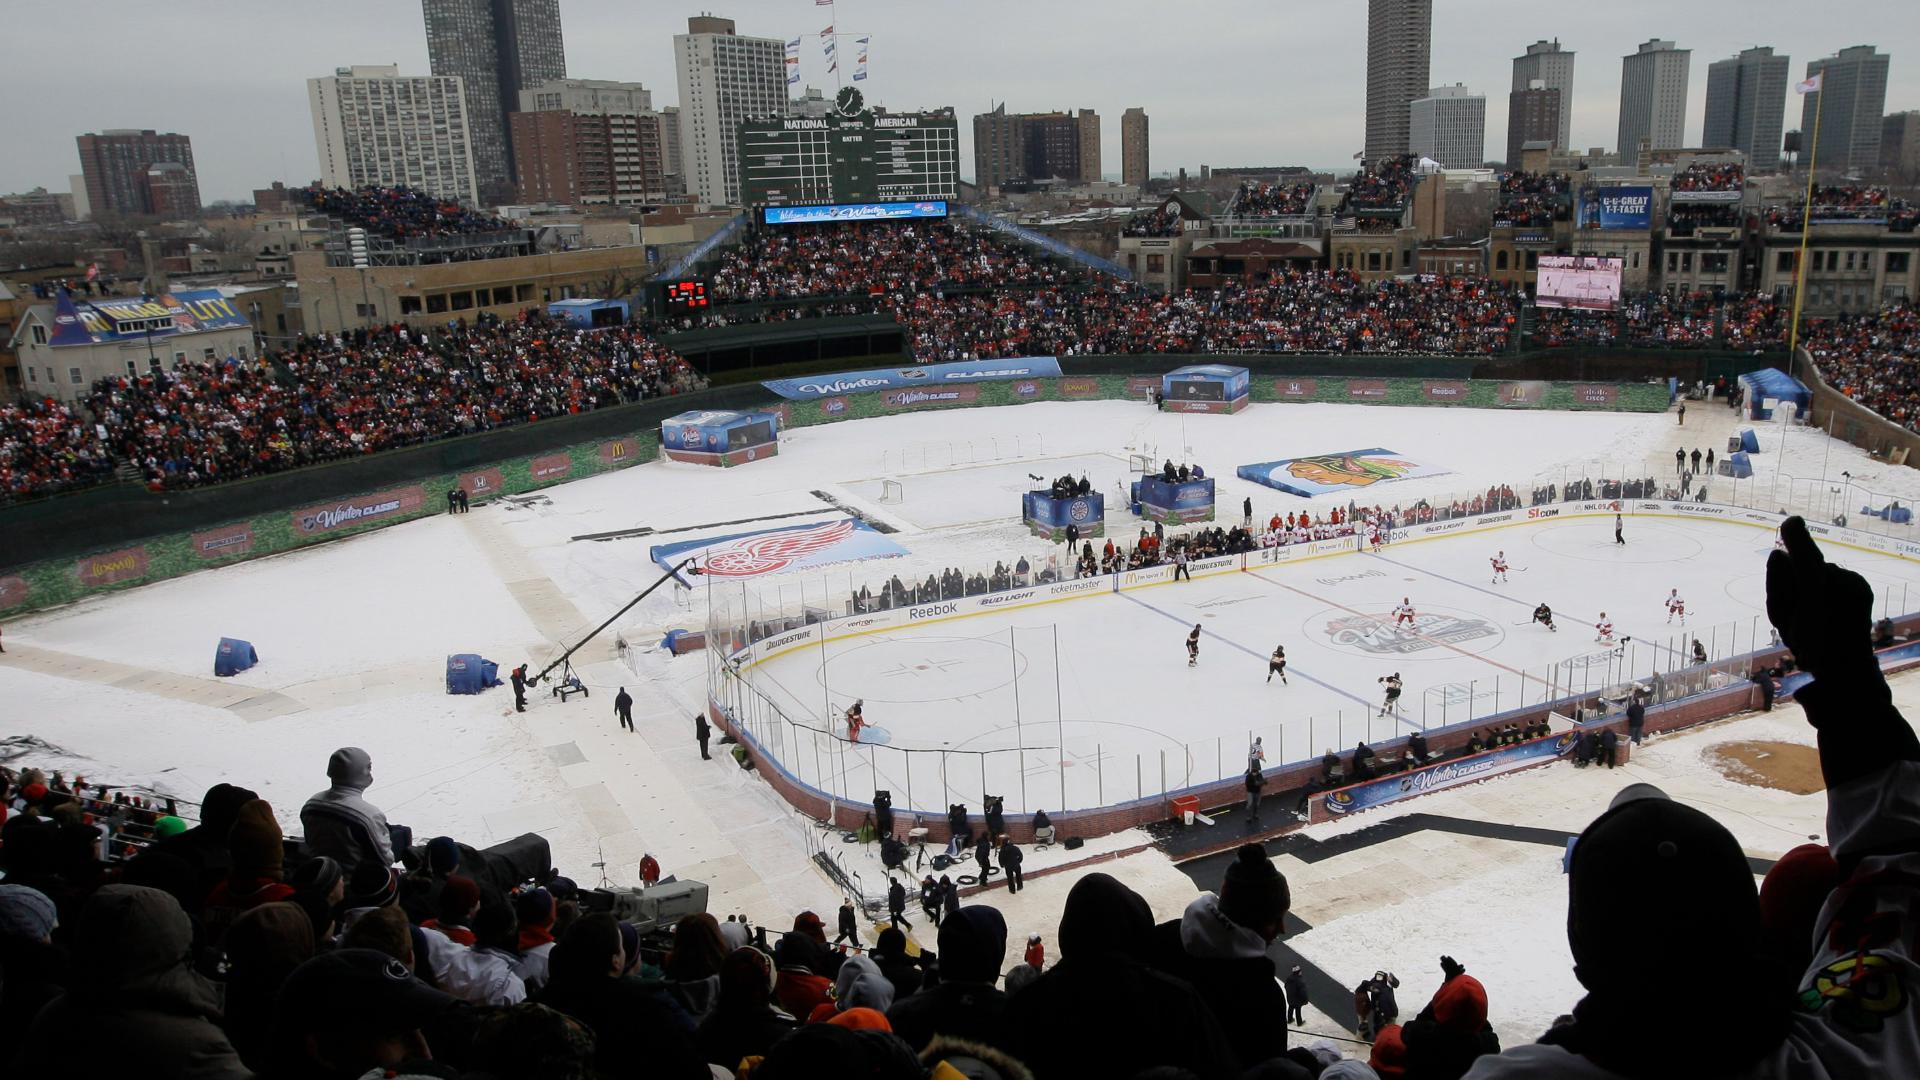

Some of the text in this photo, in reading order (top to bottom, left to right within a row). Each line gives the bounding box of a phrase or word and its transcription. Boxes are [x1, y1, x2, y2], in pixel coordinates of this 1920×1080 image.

[784, 119, 829, 130] NATIONAL
[874, 118, 917, 127] AMERICAN
[1603, 197, 1648, 205] G-G-GREAT
[840, 206, 886, 217] Winter
[1606, 205, 1645, 214] T-T-TASTE
[798, 368, 1030, 394] Winter CLASSIC
[897, 390, 959, 405] Winter CLASSIC
[316, 500, 400, 528] Winter CLASSIC
[1695, 506, 1724, 514] LIGHT
[1443, 521, 1465, 530] LIGHT
[1051, 580, 1101, 595] ticketmaster
[980, 591, 1036, 606] BUD LIGHT
[909, 602, 957, 620] Reebok
[847, 618, 873, 628] verizon
[766, 629, 812, 651] BRIDGESTONE
[1414, 766, 1458, 791] Winter
[1457, 760, 1494, 777] CLASSIC
